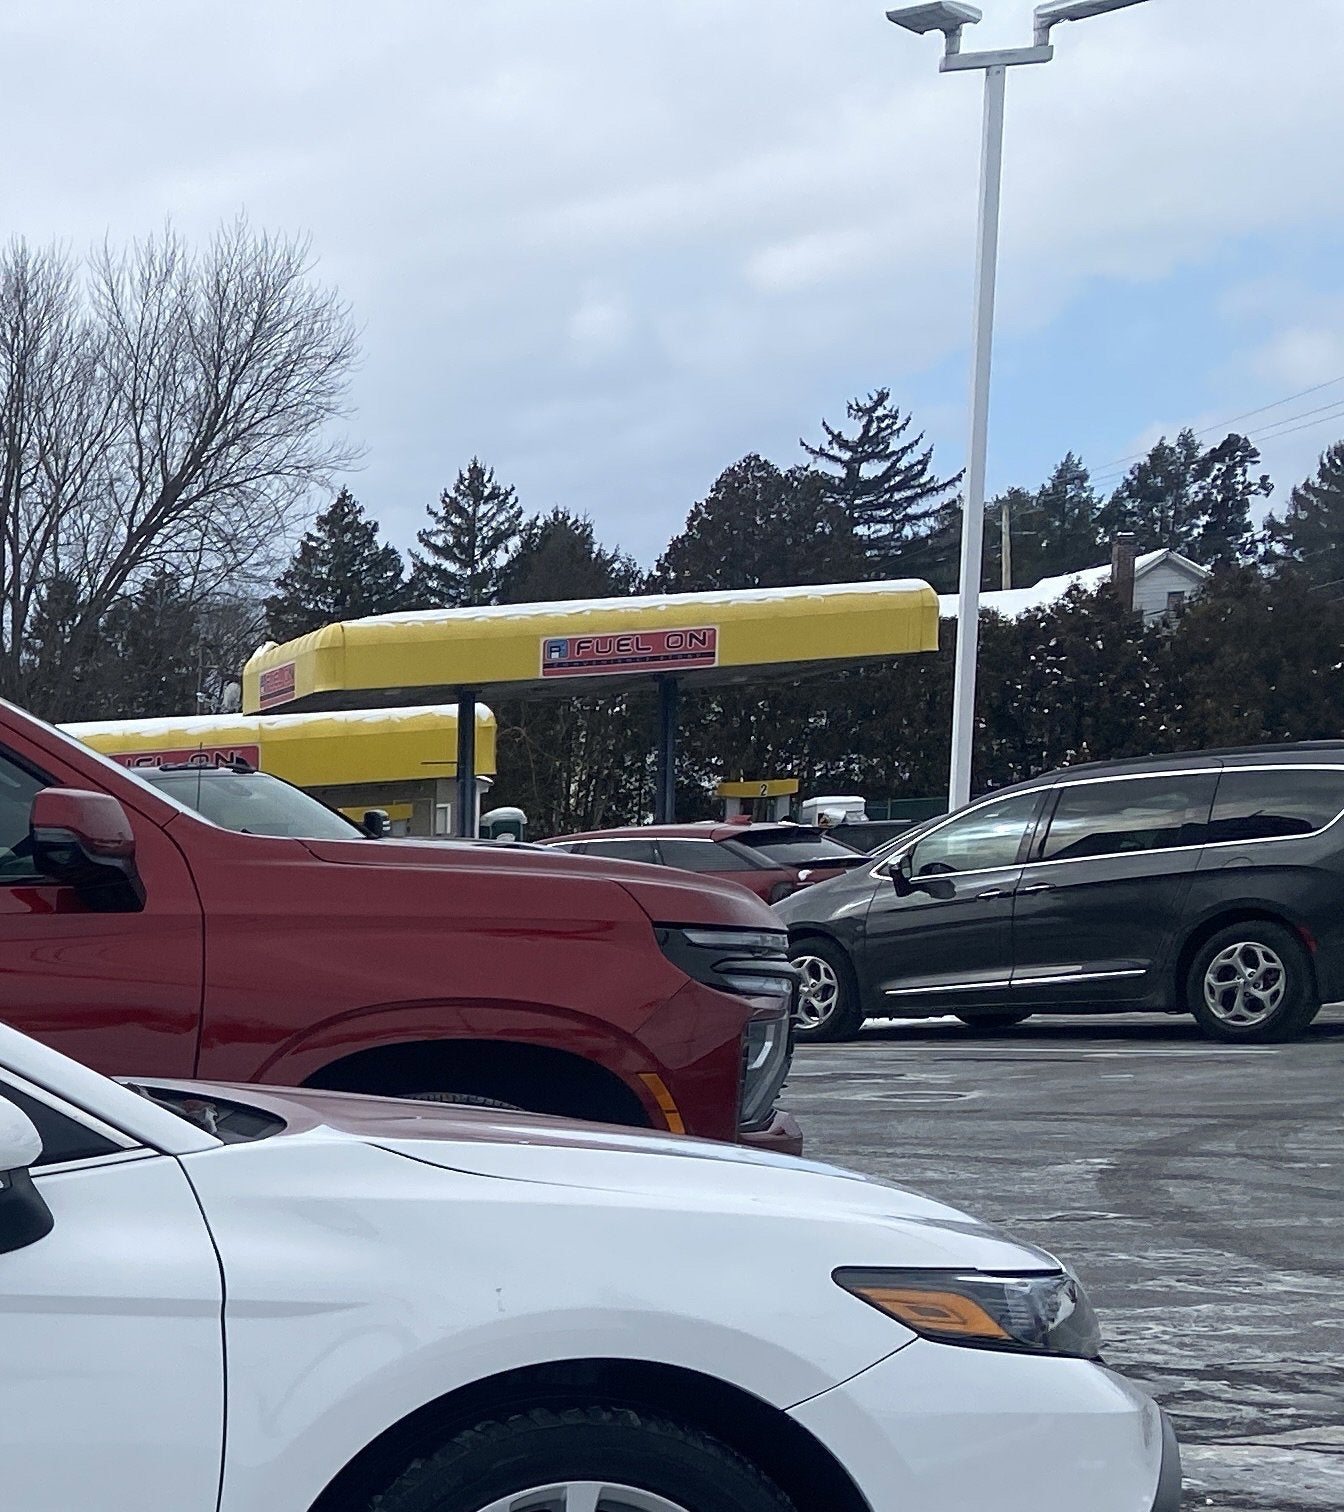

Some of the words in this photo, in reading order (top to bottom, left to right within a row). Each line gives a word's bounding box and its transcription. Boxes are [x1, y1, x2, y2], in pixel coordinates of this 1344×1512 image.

[575, 635, 652, 656] FUEL
[665, 630, 708, 650] ON
[760, 783, 768, 797] 2
